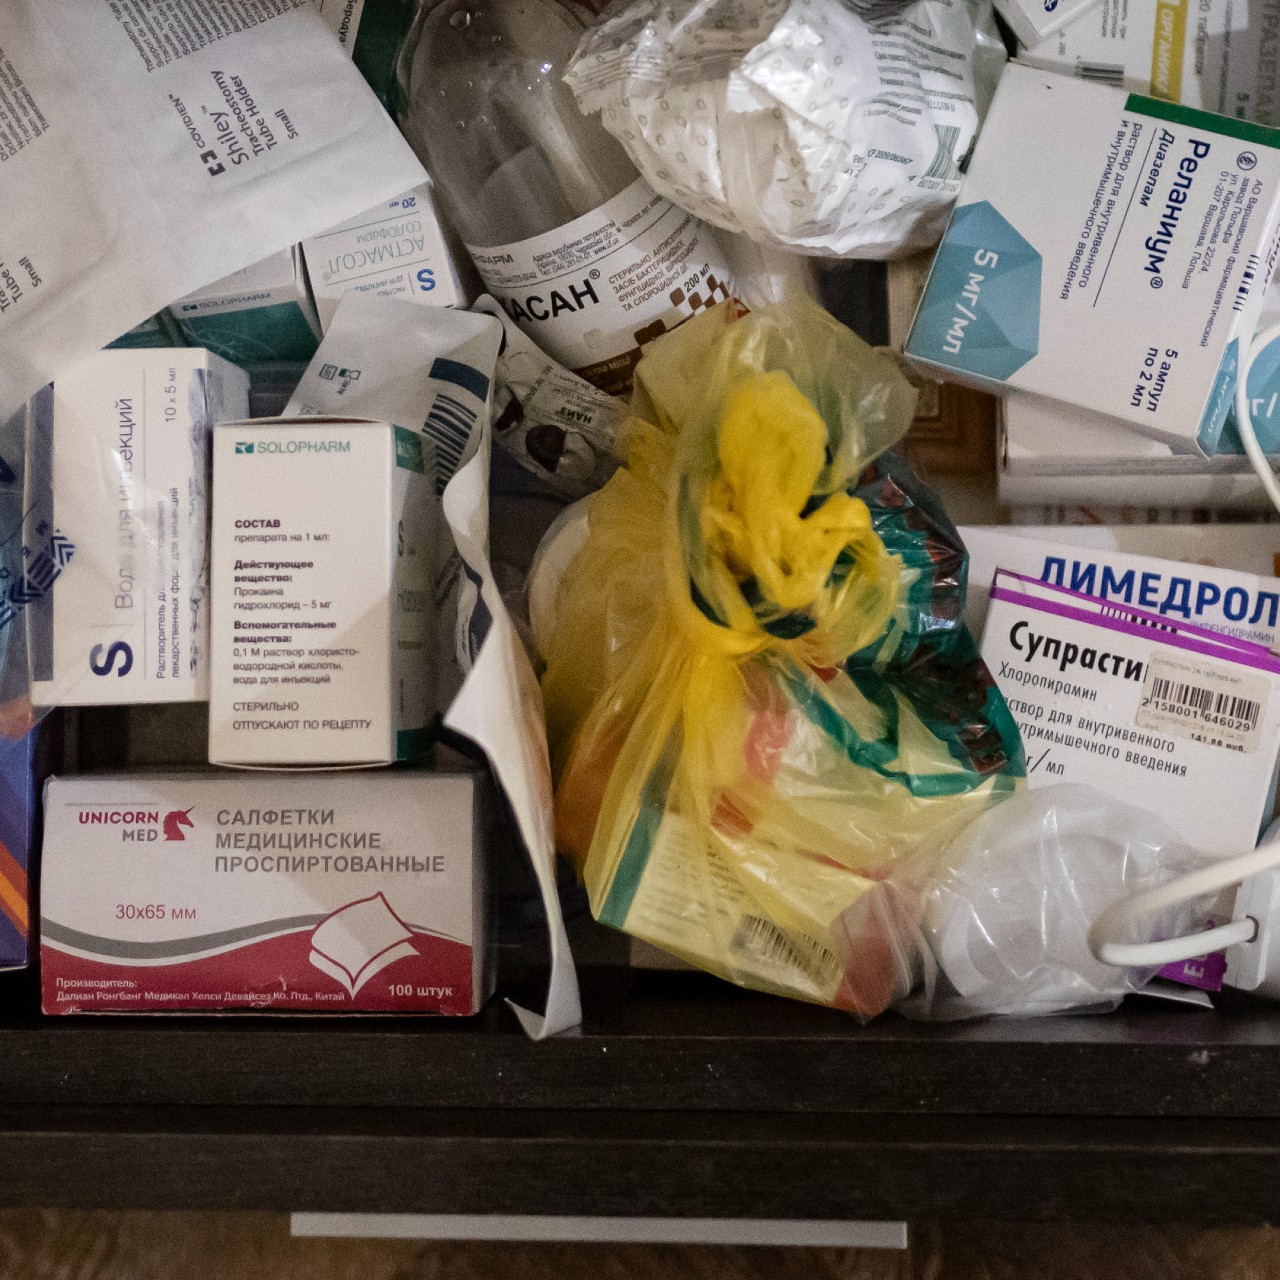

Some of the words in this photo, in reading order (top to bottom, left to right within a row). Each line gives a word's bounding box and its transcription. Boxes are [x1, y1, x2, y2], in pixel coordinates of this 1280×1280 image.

[227, 71, 261, 118] Holder
[207, 66, 267, 157] Tracheostomy
[274, 107, 299, 140] Small
[252, 115, 279, 150] Tube
[1116, 120, 1144, 172] раствор
[1136, 127, 1175, 208] Диазепам
[1079, 129, 1127, 240] внутримышечного
[1107, 172, 1126, 198] для
[1210, 169, 1230, 202] 01-207
[1234, 175, 1252, 203] завод
[401, 197, 416, 208] 20
[1208, 189, 1235, 245] Каролькова
[1219, 204, 1242, 244] Польфа
[1229, 195, 1258, 253] Варшавский
[1076, 197, 1118, 289] внутривенного
[970, 246, 999, 270] 5
[1179, 249, 1202, 290] Польша
[17, 255, 42, 287] Small
[415, 267, 437, 293] S
[681, 272, 701, 291] 200
[1058, 240, 1089, 301] введения
[938, 268, 990, 358] мг/мл
[1197, 254, 1237, 348] фармацевтический
[1141, 345, 1159, 366] по
[1162, 346, 1179, 360] 5
[1136, 369, 1151, 381] 2
[1144, 361, 1173, 413] ампул
[166, 384, 176, 393] 5
[1128, 383, 1147, 408] мл
[166, 406, 176, 422] 10
[258, 439, 351, 453] SOLOPHARM
[235, 518, 281, 529] СОСТАВ
[234, 533, 287, 544] препарата
[235, 558, 314, 570] Действующее
[234, 573, 293, 584] вещество:
[234, 585, 283, 596] Прокаина
[233, 599, 300, 611] гидрохлорид
[169, 596, 180, 678] лекарственных
[234, 619, 336, 631] Вспомогательные
[156, 604, 167, 678] Растворитель
[233, 633, 292, 644] вещества:
[89, 640, 133, 676] S
[263, 647, 304, 659] раствор
[1008, 620, 1150, 683] Супрасти
[232, 660, 296, 672] водородной
[282, 673, 331, 686] инъекций
[996, 661, 1100, 705] Хлоропирамин
[233, 700, 299, 712] СТЕРИЛЬНО
[1153, 699, 1198, 719] 158001
[1203, 712, 1251, 733] 646029
[232, 718, 300, 731] ОТПУСКАЮТ
[303, 718, 320, 730] ПО
[322, 717, 372, 731] РЕЦЕПТУ
[1000, 696, 1044, 722] аствор
[1046, 707, 1073, 730] для
[1076, 715, 1176, 755] внутривенного
[1024, 745, 1067, 778] г/мл
[1123, 746, 1189, 779] введения
[78, 810, 159, 824] UNICORN
[216, 808, 335, 825] САЛФЕТКИ
[122, 828, 158, 842] MED
[215, 832, 382, 851] МЕДИЦИНСКИЕ
[214, 855, 446, 873] ПРОСПИРТОВАННЫЕ
[171, 908, 197, 920] мм
[56, 977, 137, 988] Производитель:
[389, 983, 412, 996] 100
[417, 985, 453, 998] штук
[56, 991, 94, 1001] Далиан
[96, 990, 141, 1000] Ронгбанг
[144, 991, 189, 1000] Медикал
